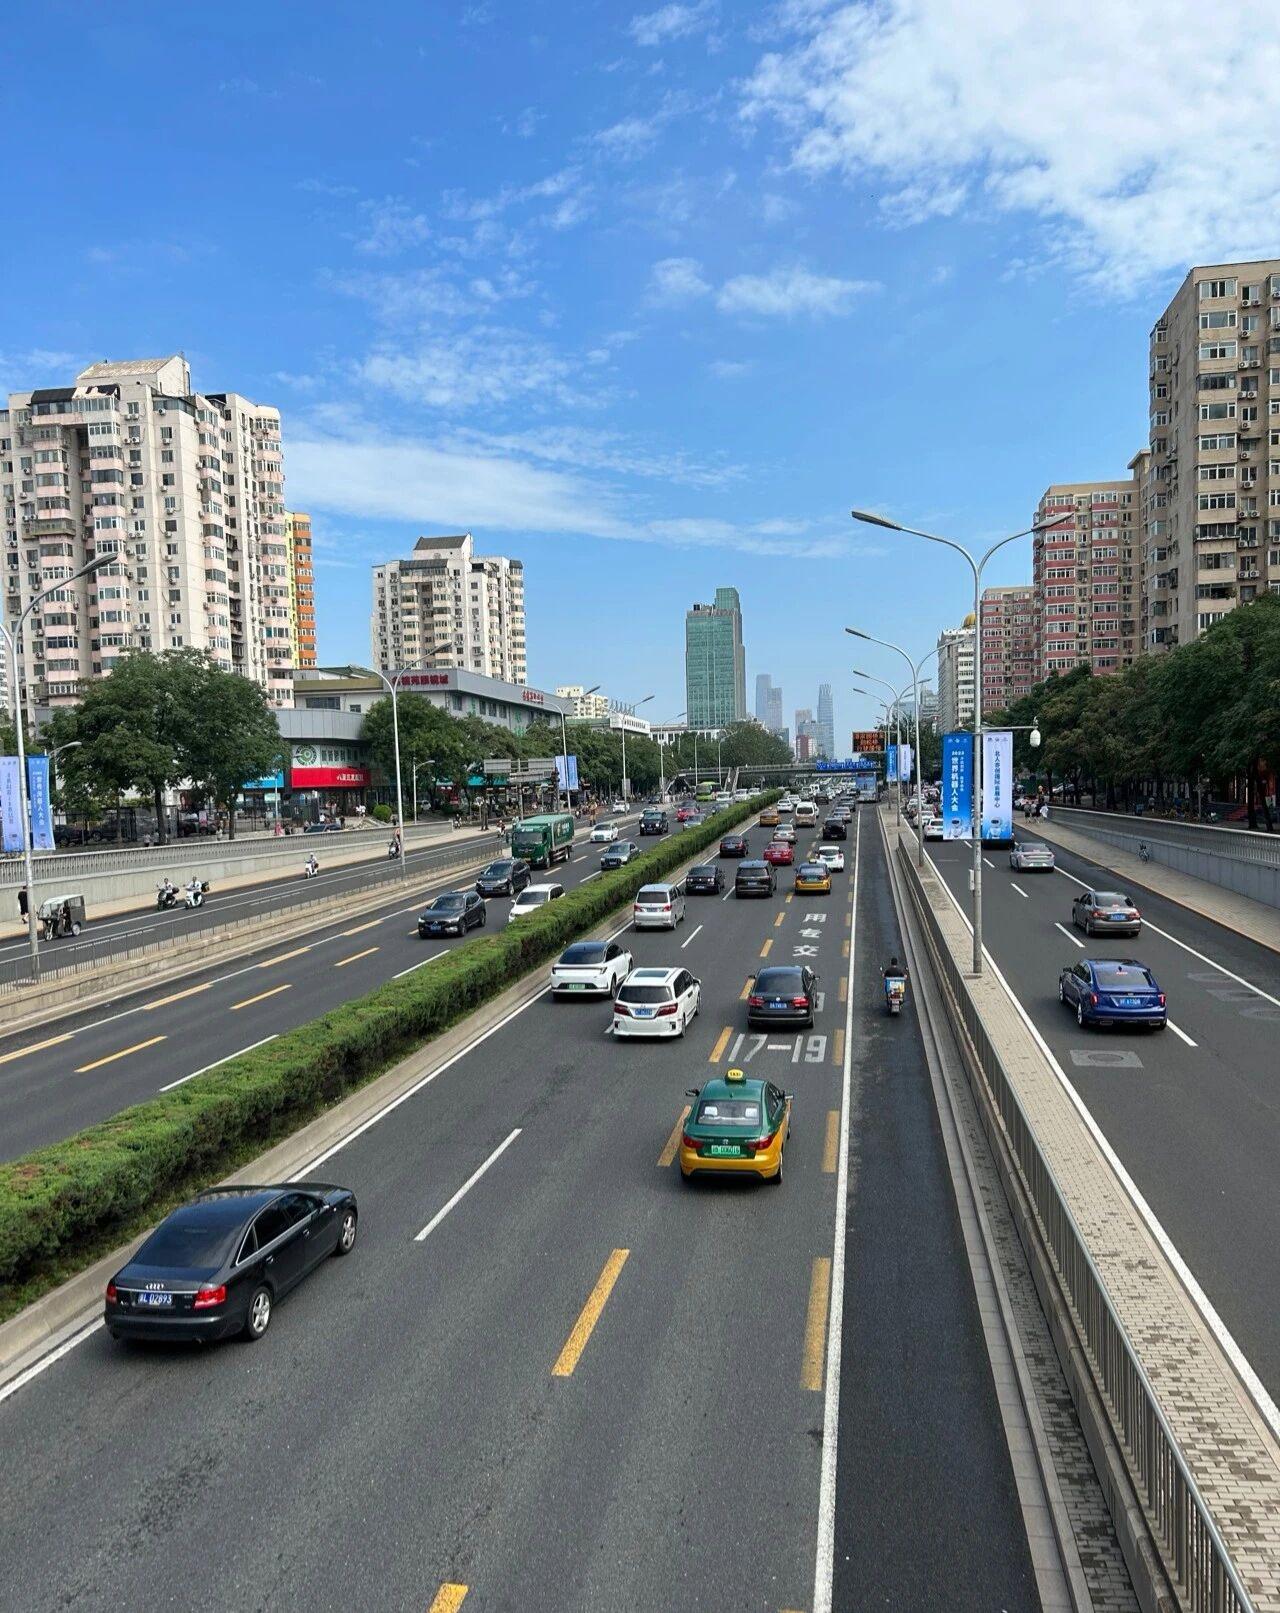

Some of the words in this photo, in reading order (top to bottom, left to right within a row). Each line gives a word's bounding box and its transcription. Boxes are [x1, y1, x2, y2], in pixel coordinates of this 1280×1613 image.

[951, 757, 959, 812] 世界机器人大会
[728, 1033, 828, 1063] 17-19
